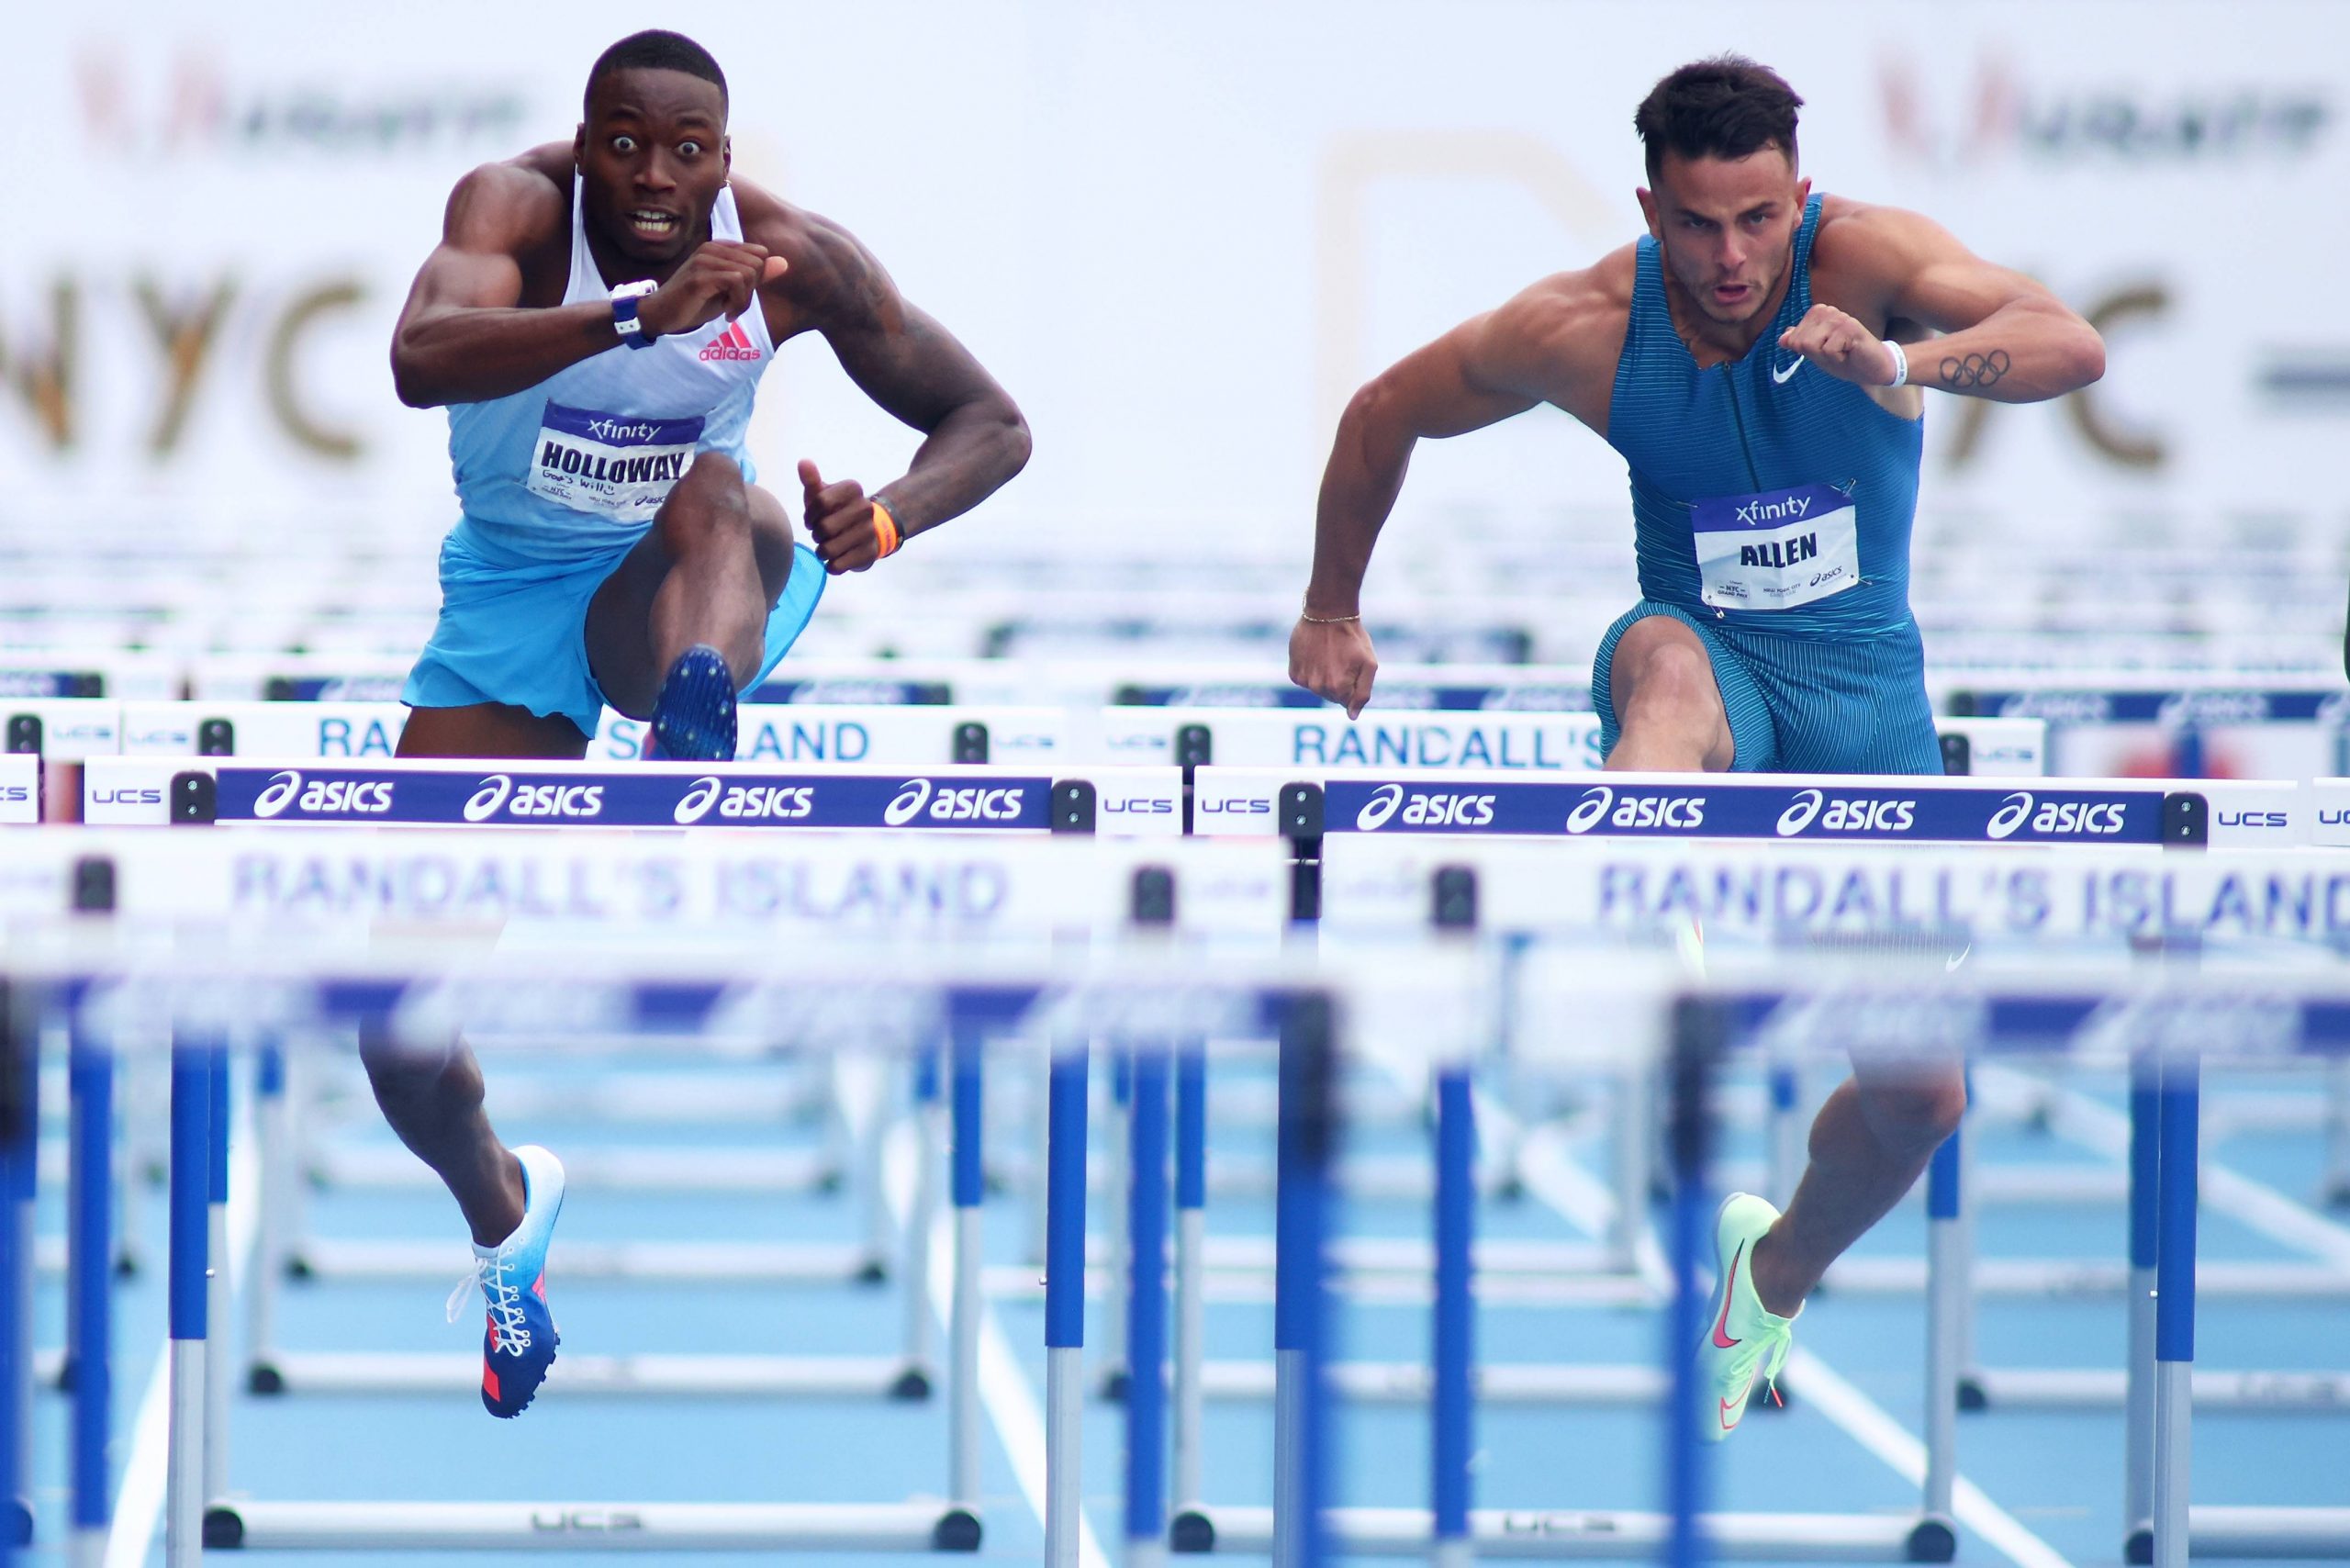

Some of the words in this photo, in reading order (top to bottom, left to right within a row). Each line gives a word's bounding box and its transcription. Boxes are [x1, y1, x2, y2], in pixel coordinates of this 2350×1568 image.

[699, 347, 761, 361] adidas
[588, 419, 662, 442] xfinity
[541, 440, 687, 484] HOLLOWAY
[1735, 496, 1811, 526] xfinity
[1740, 532, 1818, 568] ALLEN
[93, 789, 162, 804] UCS
[299, 780, 394, 812] asics
[509, 785, 604, 817] asics
[720, 787, 814, 818] asics
[929, 788, 1024, 820] asics
[1103, 799, 1173, 813] UCS
[1202, 799, 1270, 814] UCS
[1402, 794, 1496, 825] asics
[1611, 797, 1706, 828] asics
[1821, 800, 1916, 831] asics
[2032, 802, 2127, 834] asics
[2218, 812, 2288, 827] UCS
[1598, 864, 2053, 932] RANDALL'S
